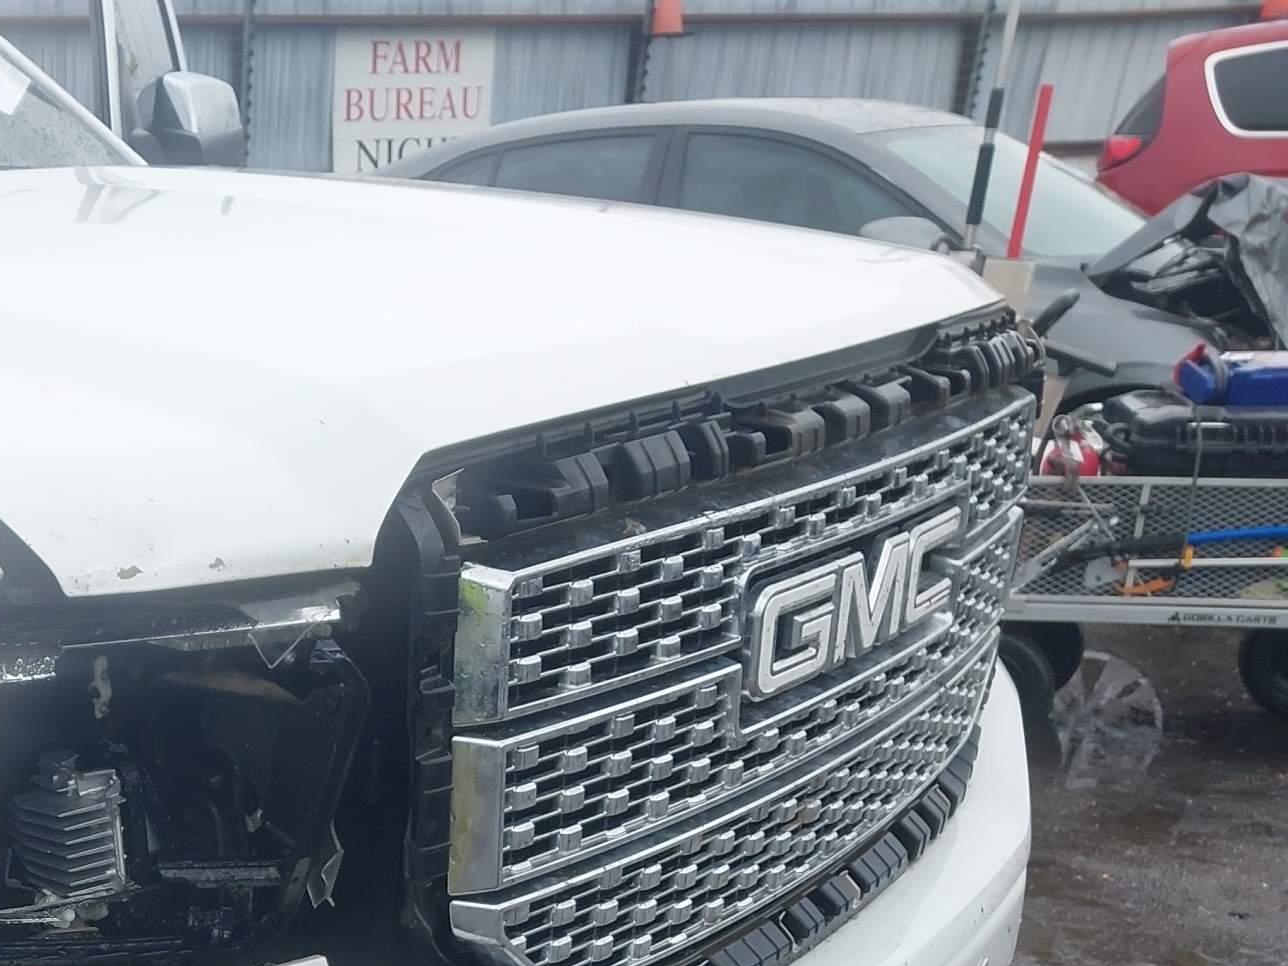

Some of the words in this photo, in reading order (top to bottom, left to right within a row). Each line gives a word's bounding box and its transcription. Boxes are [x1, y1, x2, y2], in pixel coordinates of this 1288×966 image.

[370, 40, 462, 74] FARM
[344, 87, 482, 122] BUREAU
[750, 506, 962, 701] GMC
